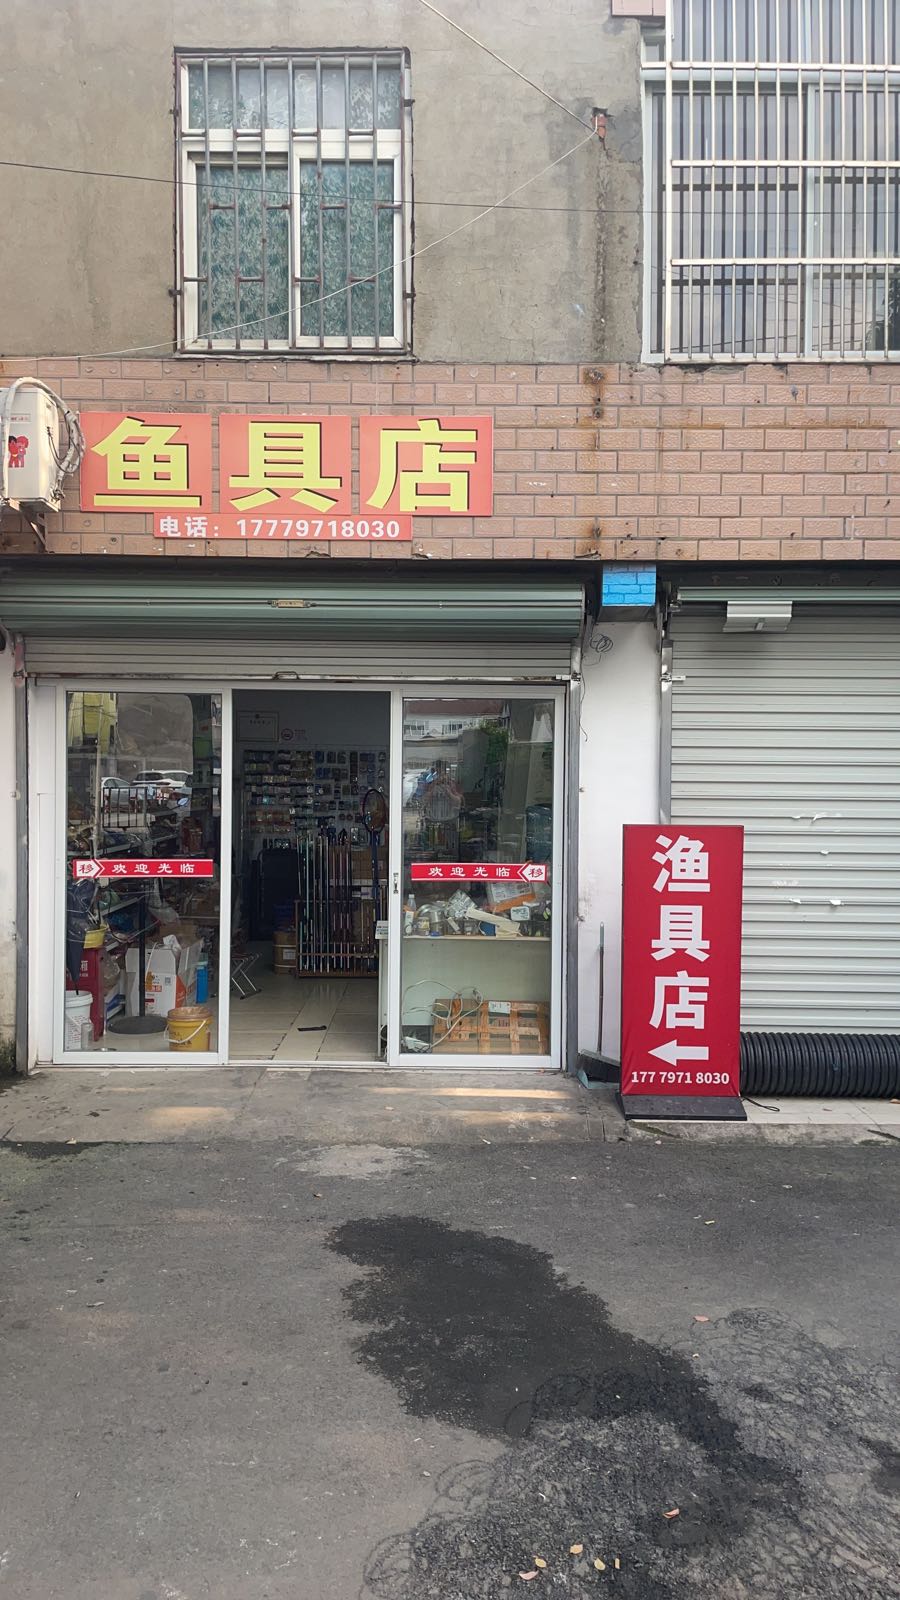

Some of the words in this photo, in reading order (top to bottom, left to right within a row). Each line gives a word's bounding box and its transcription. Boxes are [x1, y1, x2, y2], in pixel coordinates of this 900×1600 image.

[91, 416, 479, 513] 鱼具店
[78, 863, 95, 874] 移
[111, 862, 196, 874] 欢迎光临
[428, 866, 511, 877] 欢迎光临
[528, 867, 544, 878] 移
[649, 834, 711, 1029] 渔具店
